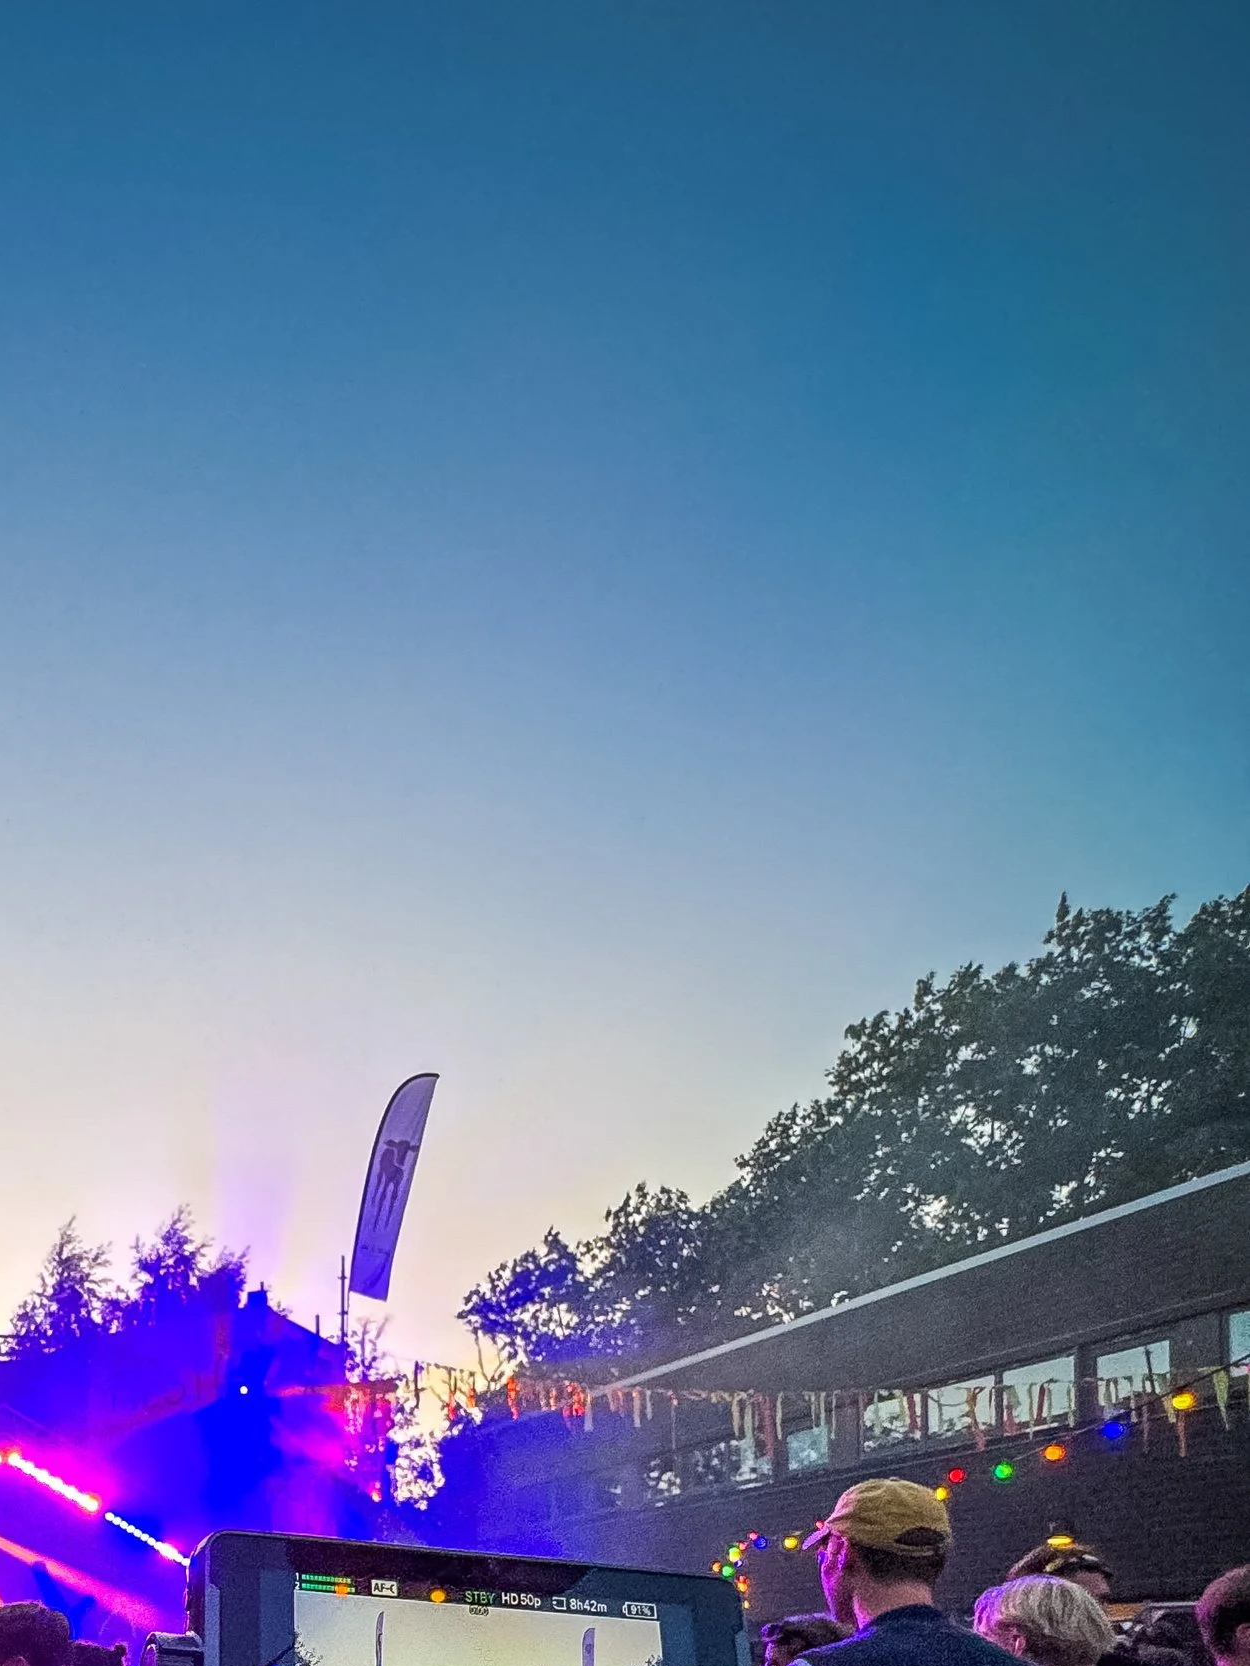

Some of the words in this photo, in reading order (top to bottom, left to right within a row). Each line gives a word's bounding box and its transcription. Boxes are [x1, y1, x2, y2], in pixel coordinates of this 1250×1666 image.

[373, 1582, 396, 1594] AF-C
[465, 1591, 495, 1604] STBY
[569, 1598, 608, 1613] 8h42m
